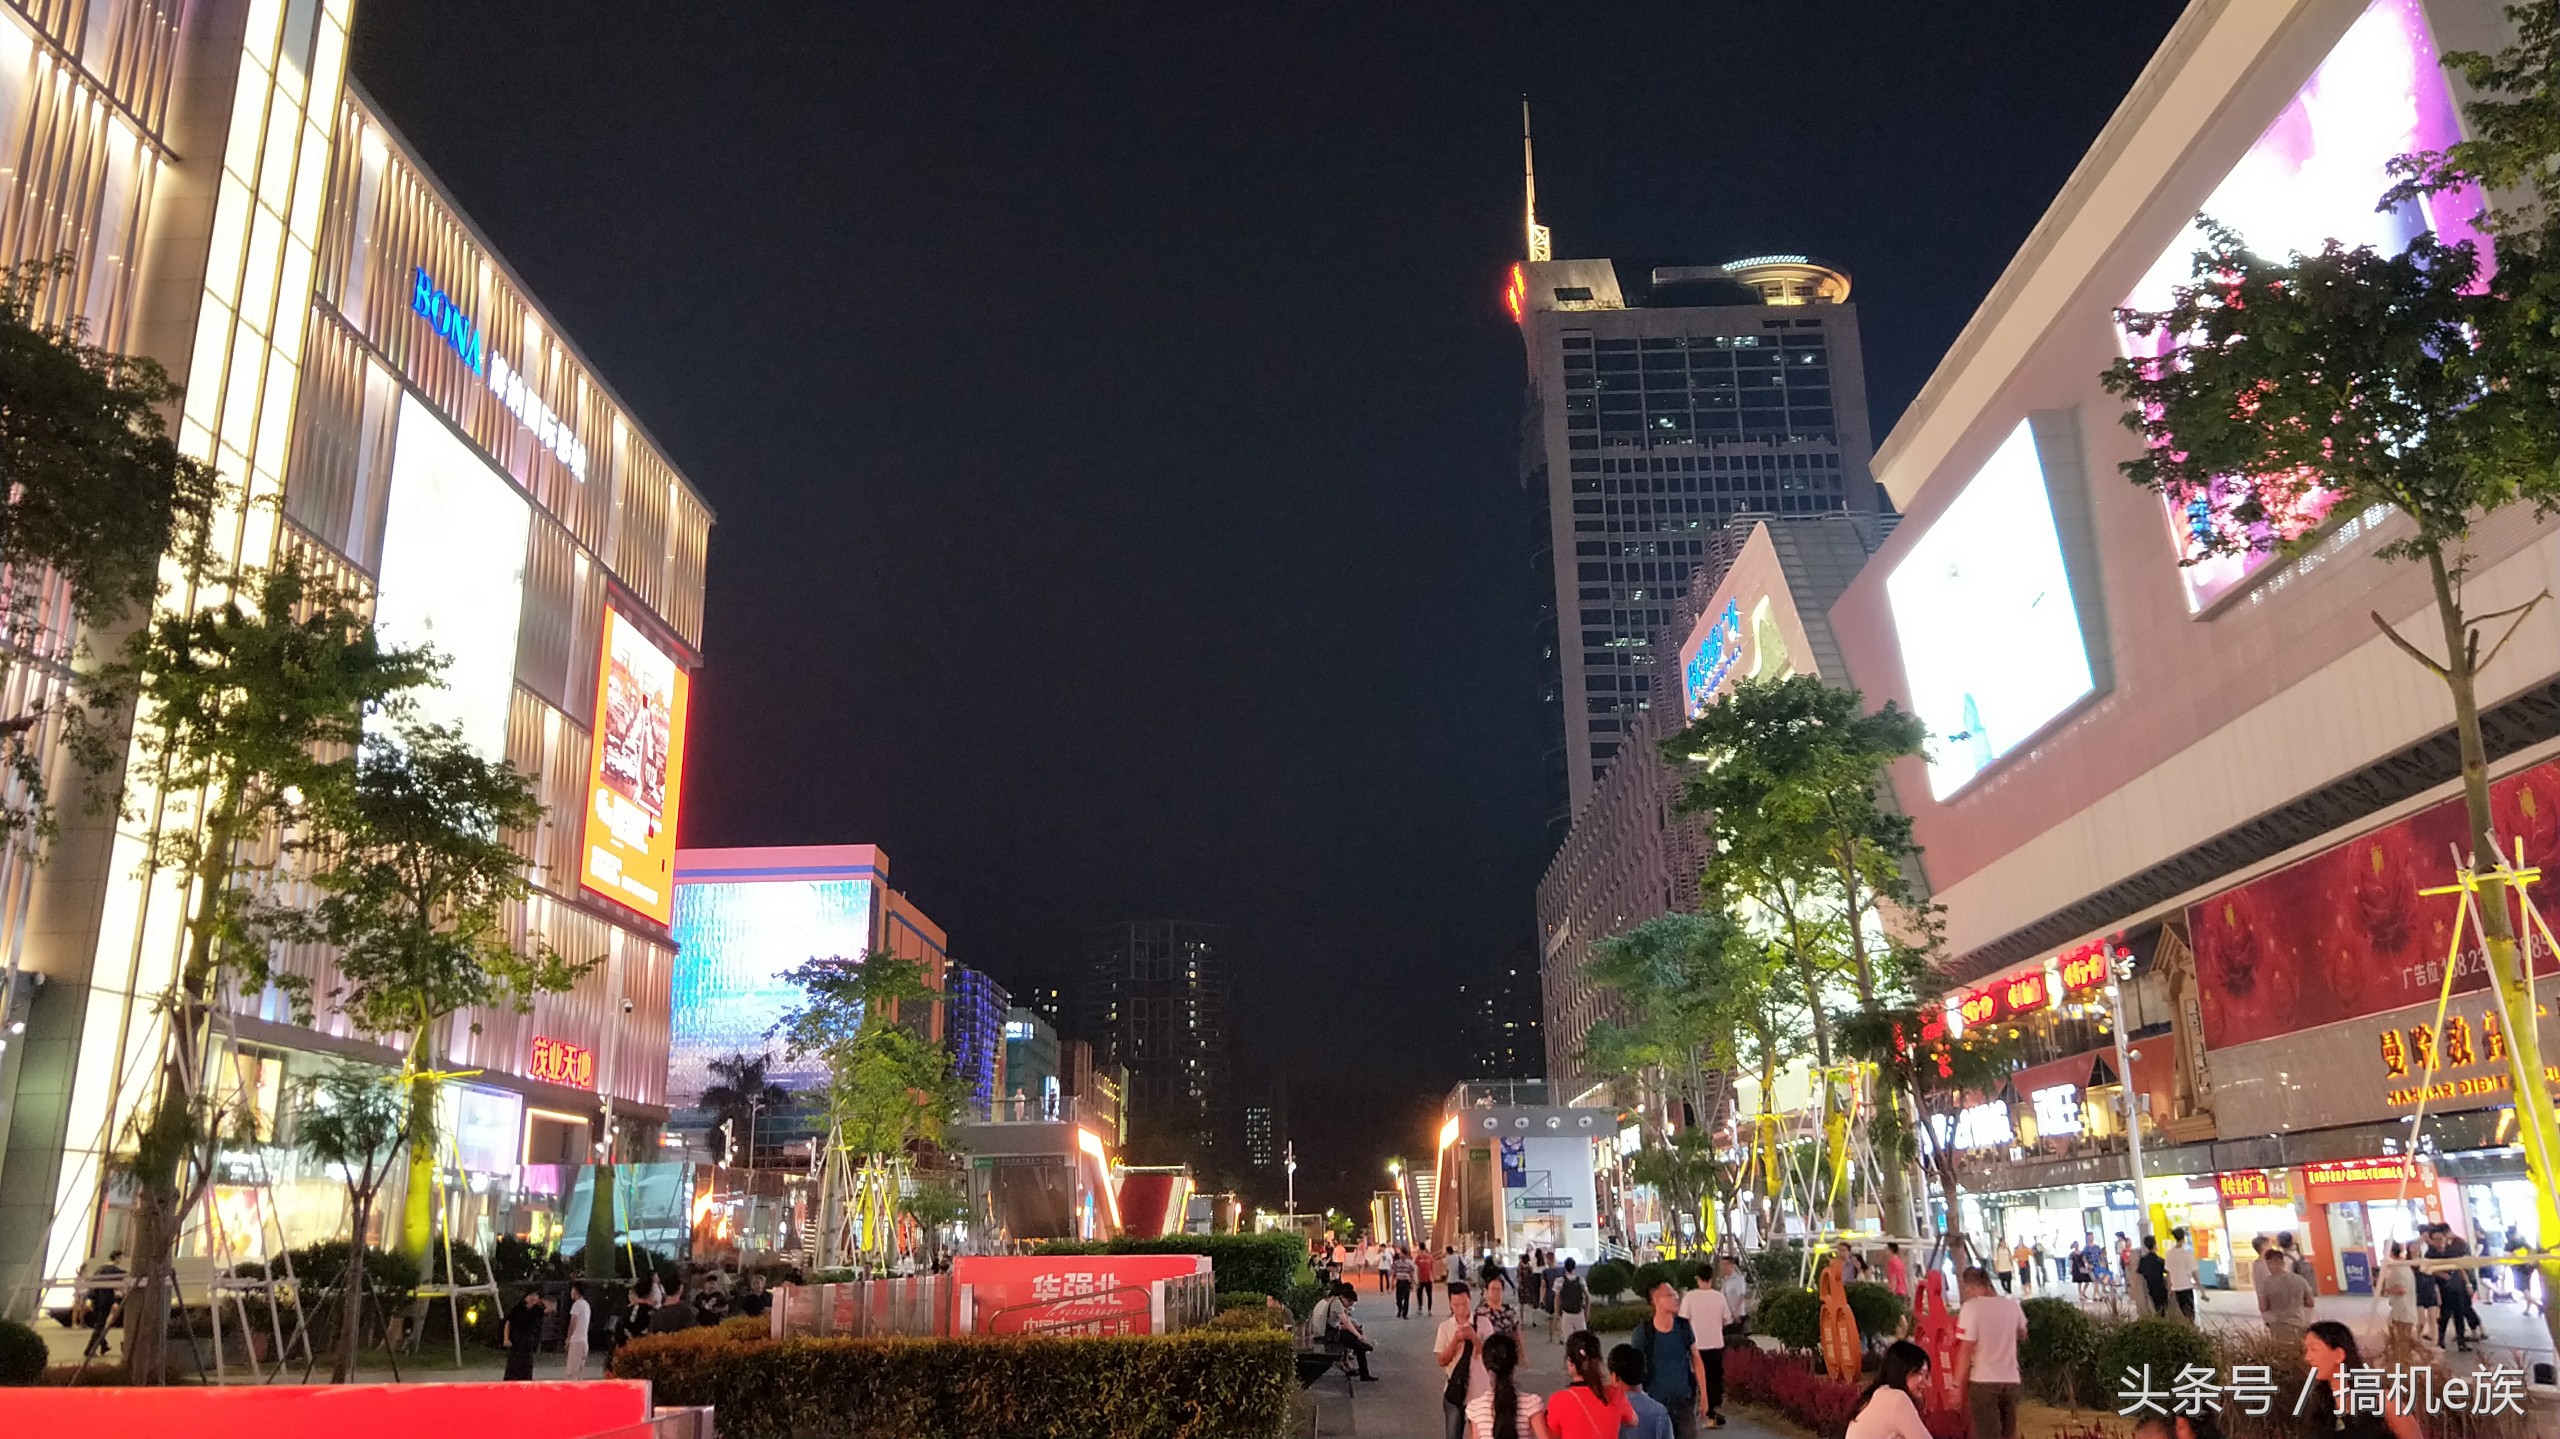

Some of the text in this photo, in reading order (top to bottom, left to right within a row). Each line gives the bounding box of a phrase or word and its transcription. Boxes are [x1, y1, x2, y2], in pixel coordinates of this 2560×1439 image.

[412, 267, 482, 376] BONA
[2402, 960, 2441, 990] 广告位
[2441, 953, 2468, 978] 18
[531, 1036, 592, 1087] 茂业天地
[1031, 1272, 1123, 1308] 华强北
